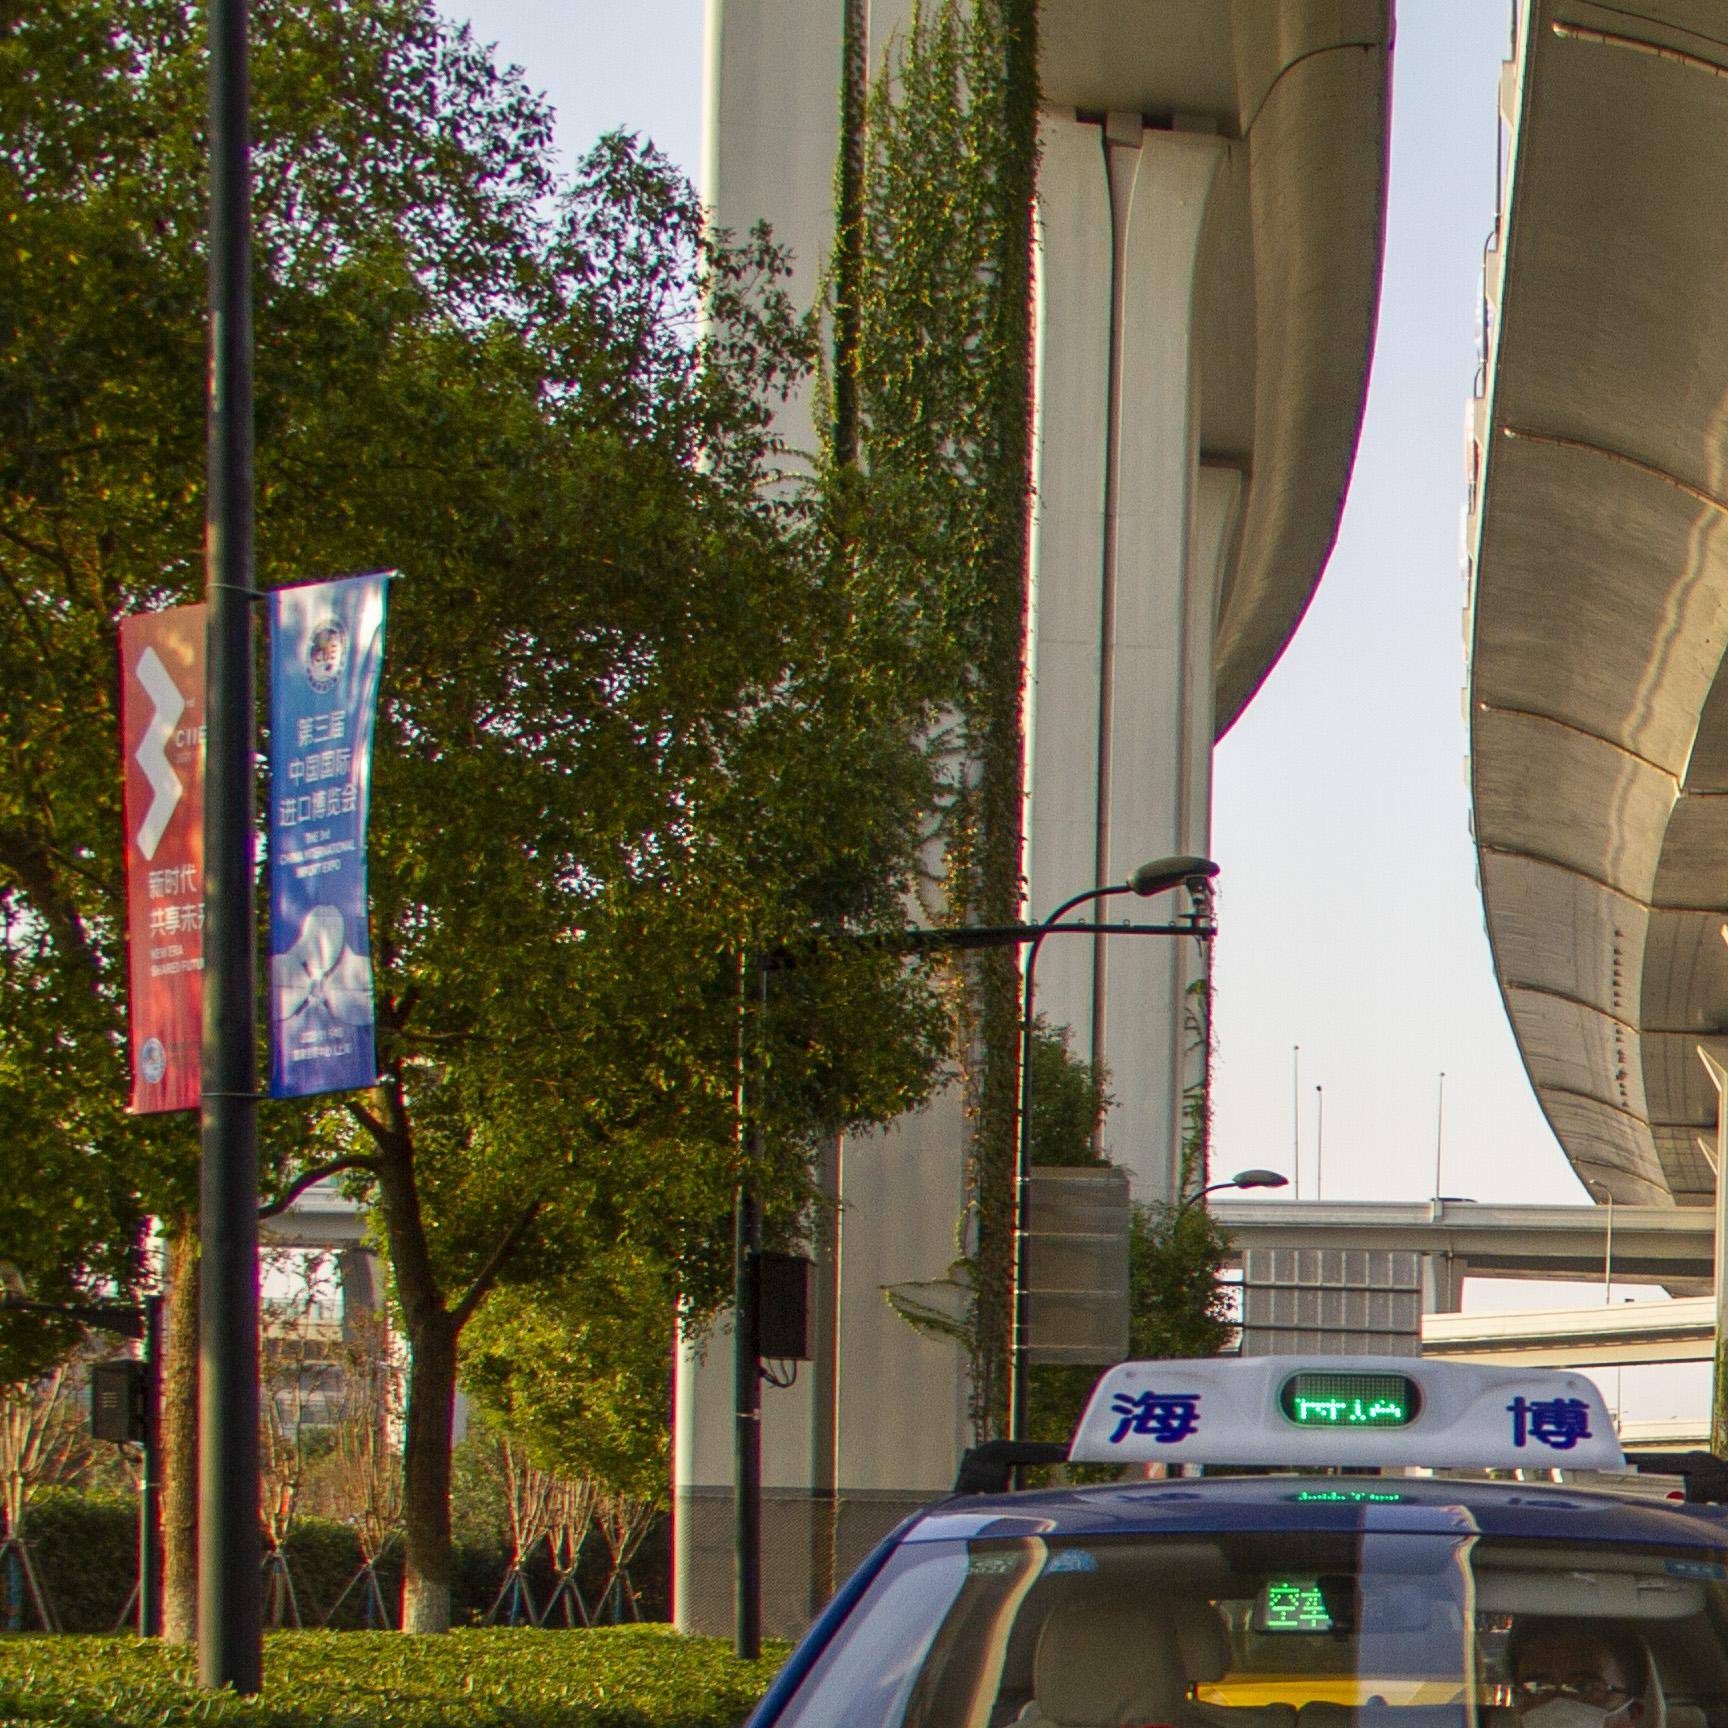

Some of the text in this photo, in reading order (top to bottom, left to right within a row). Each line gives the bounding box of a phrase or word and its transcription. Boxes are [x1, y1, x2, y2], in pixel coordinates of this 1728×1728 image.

[298, 710, 346, 748] 第三届
[288, 748, 351, 787] 中国国际
[279, 784, 358, 827] 进口博览会
[148, 863, 197, 900] 新时代
[1109, 1390, 1593, 1449] 海 博
[1267, 1583, 1329, 1627] 空车
